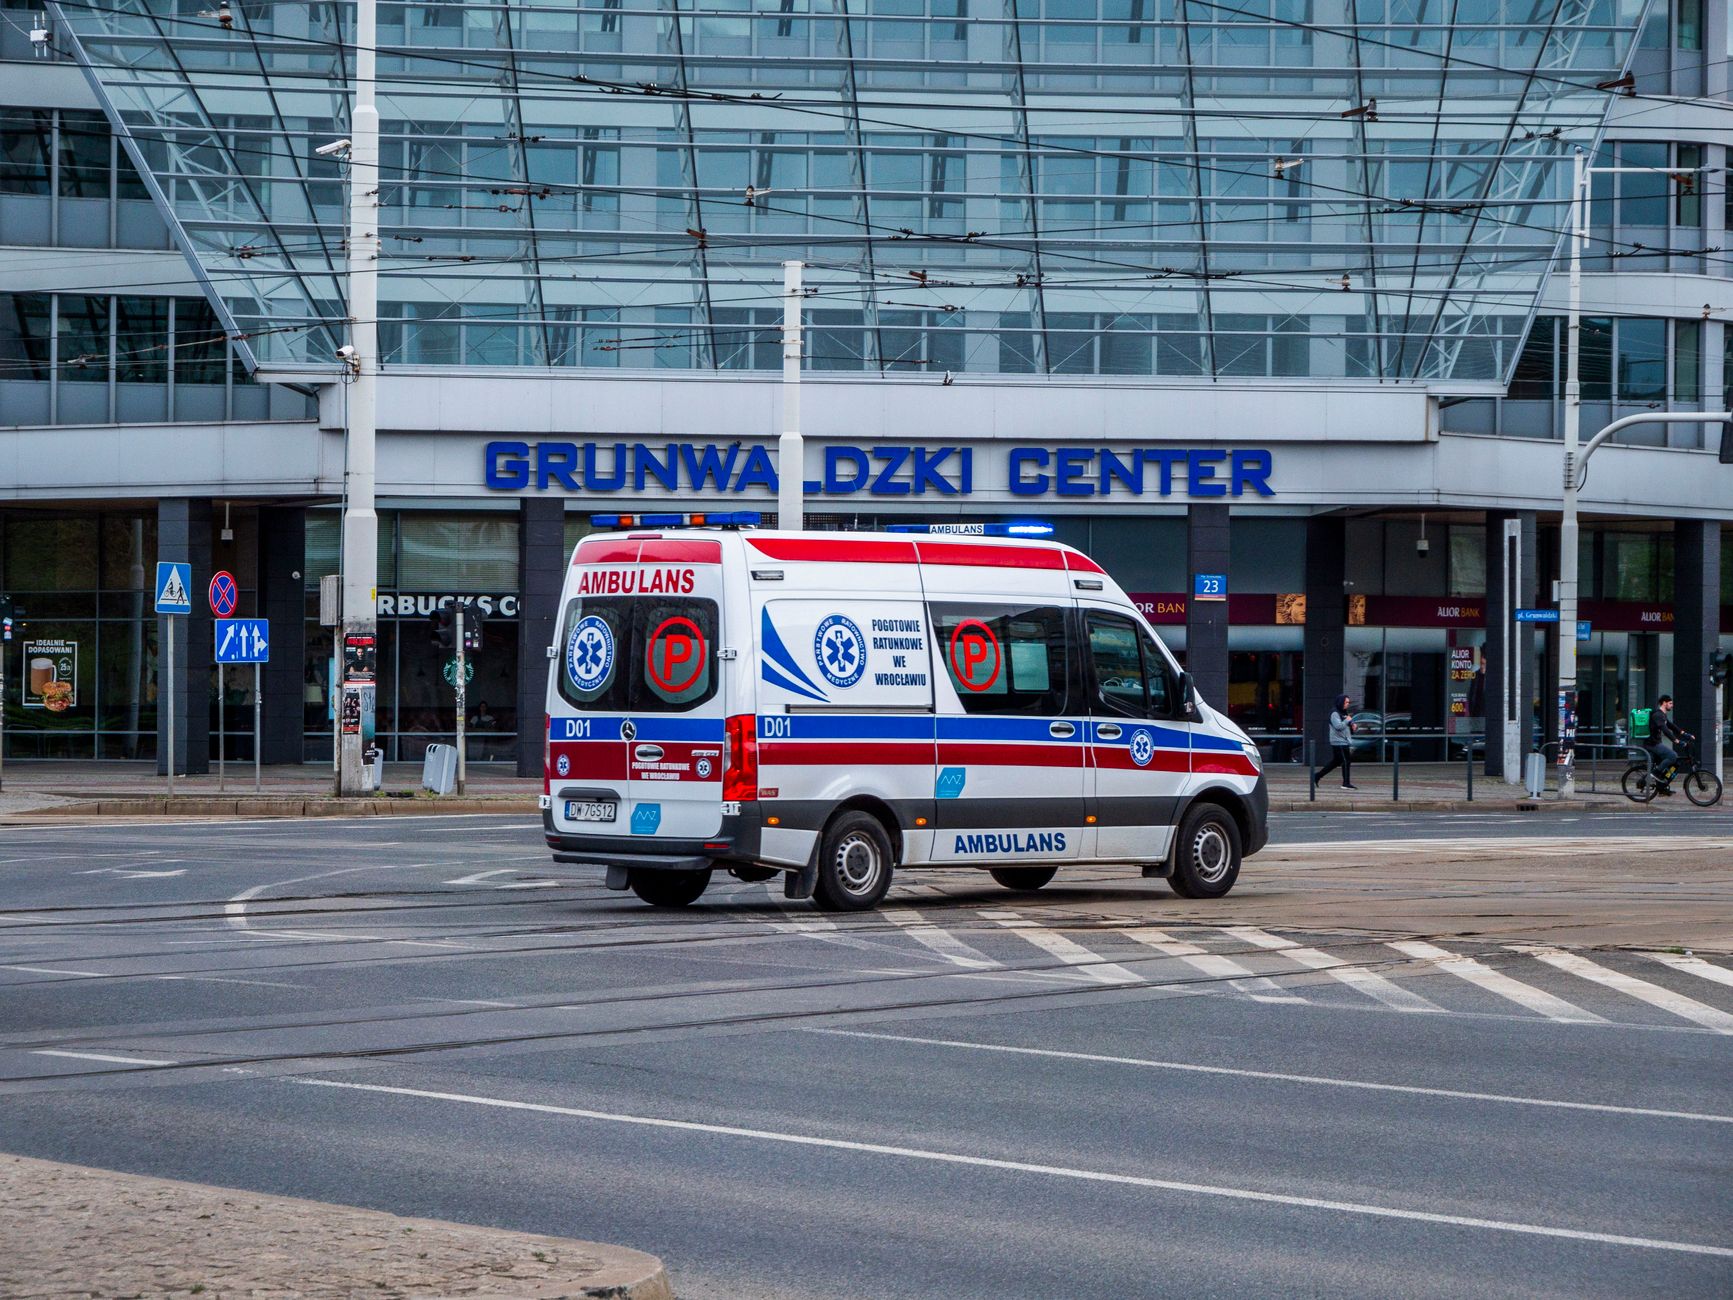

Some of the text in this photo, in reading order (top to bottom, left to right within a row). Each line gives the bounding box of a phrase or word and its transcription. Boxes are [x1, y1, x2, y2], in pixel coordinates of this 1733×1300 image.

[1009, 447, 1276, 497] CENTER
[931, 525, 983, 535] AMBULANS
[578, 569, 695, 594] AMBULANS
[1203, 580, 1219, 593] 23
[1157, 602, 1185, 613] BAN
[1437, 606, 1480, 617] ALIOR BANK
[1641, 611, 1661, 622] ALIOR
[871, 619, 921, 632] POGOTOWIE
[873, 637, 923, 650] RATUNKOWE
[663, 634, 692, 680] P
[962, 634, 987, 679] P
[1451, 650, 1470, 659] ALIOR
[893, 656, 906, 667] WE
[1451, 660, 1472, 669] KONTO
[573, 674, 603, 687] MEDYCZNE
[826, 672, 860, 686] MEDYCZNE
[875, 673, 926, 686] WROCŁAWIU
[566, 719, 590, 737] D01
[764, 717, 791, 737] D01
[585, 804, 613, 818] 7GS12
[954, 832, 1066, 854] AMBULANS
